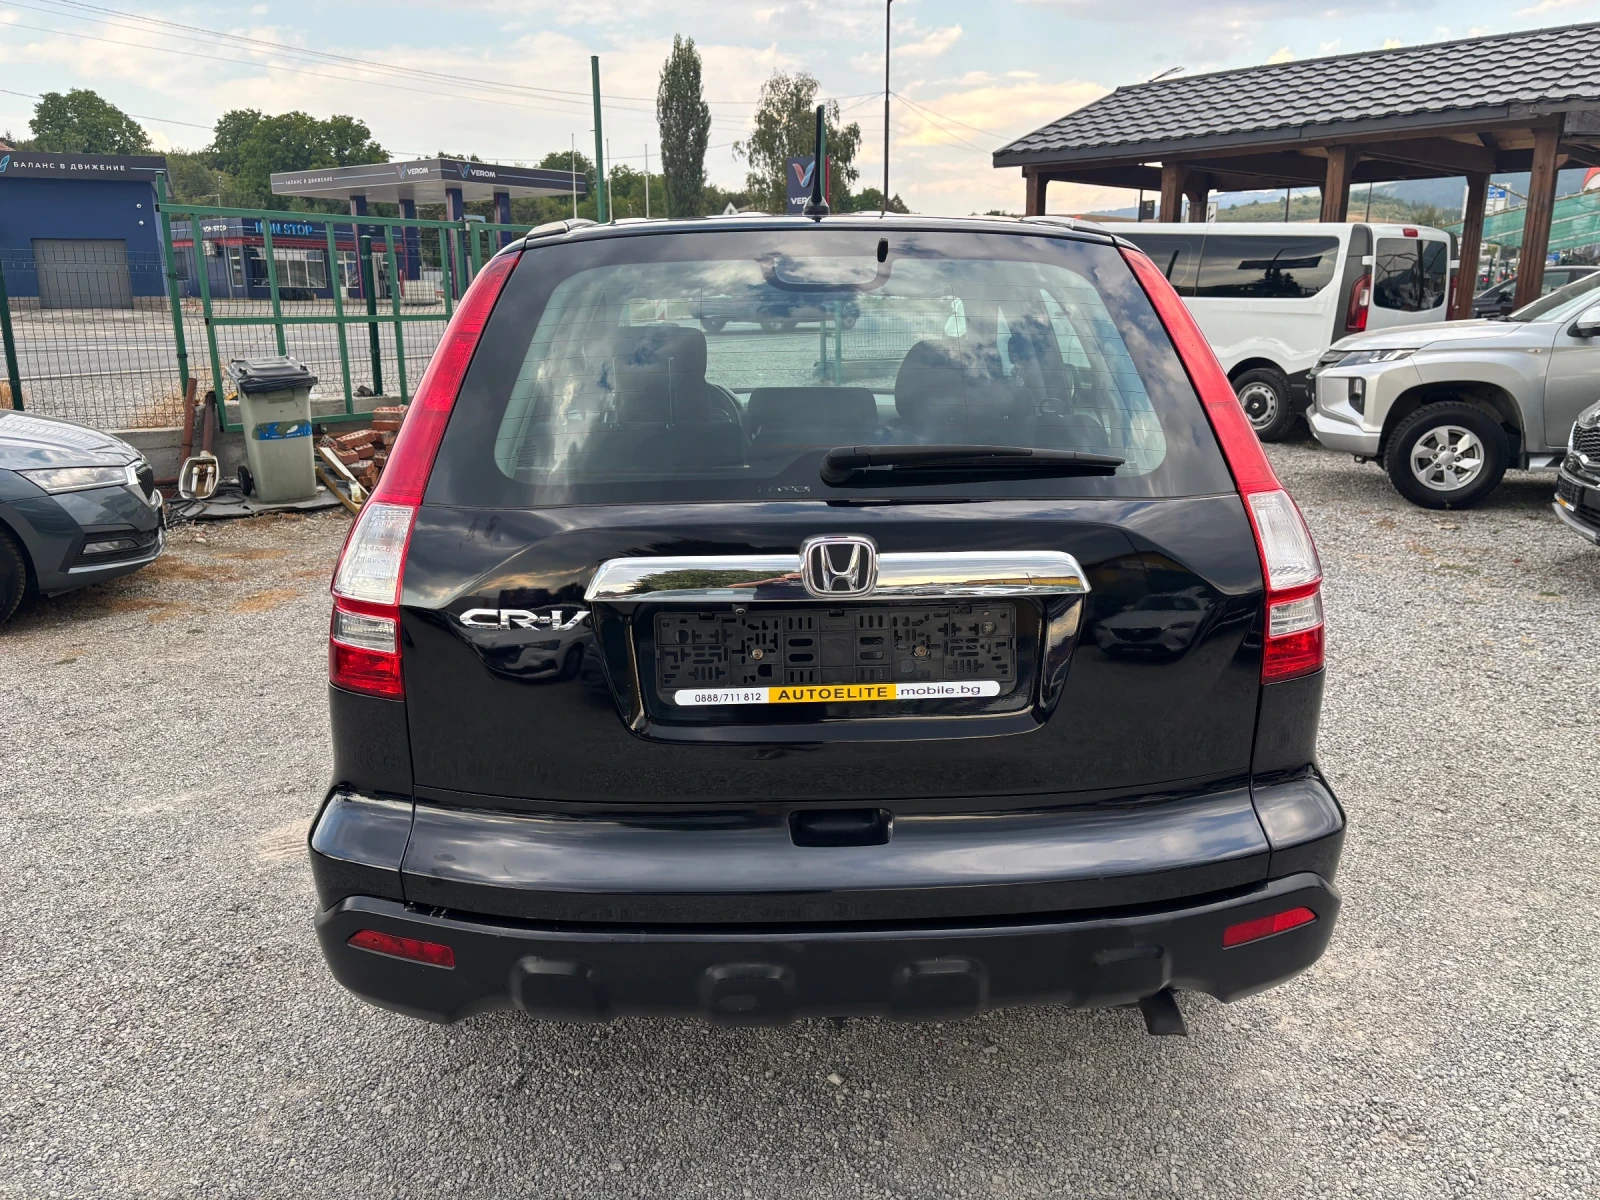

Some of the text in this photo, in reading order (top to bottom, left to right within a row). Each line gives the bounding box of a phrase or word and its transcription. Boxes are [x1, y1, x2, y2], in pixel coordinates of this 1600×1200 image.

[13, 161, 56, 169] БАЛАНС
[70, 163, 126, 171] ДВИЖЕНИЕ
[406, 167, 429, 175] VEROM
[470, 169, 496, 178] VEROM
[790, 197, 808, 205] VER
[283, 223, 313, 236] STOP
[459, 608, 591, 632] CR-V
[694, 693, 741, 704] 0888/711
[743, 692, 762, 702] 812
[777, 686, 889, 701] AUTOELITE
